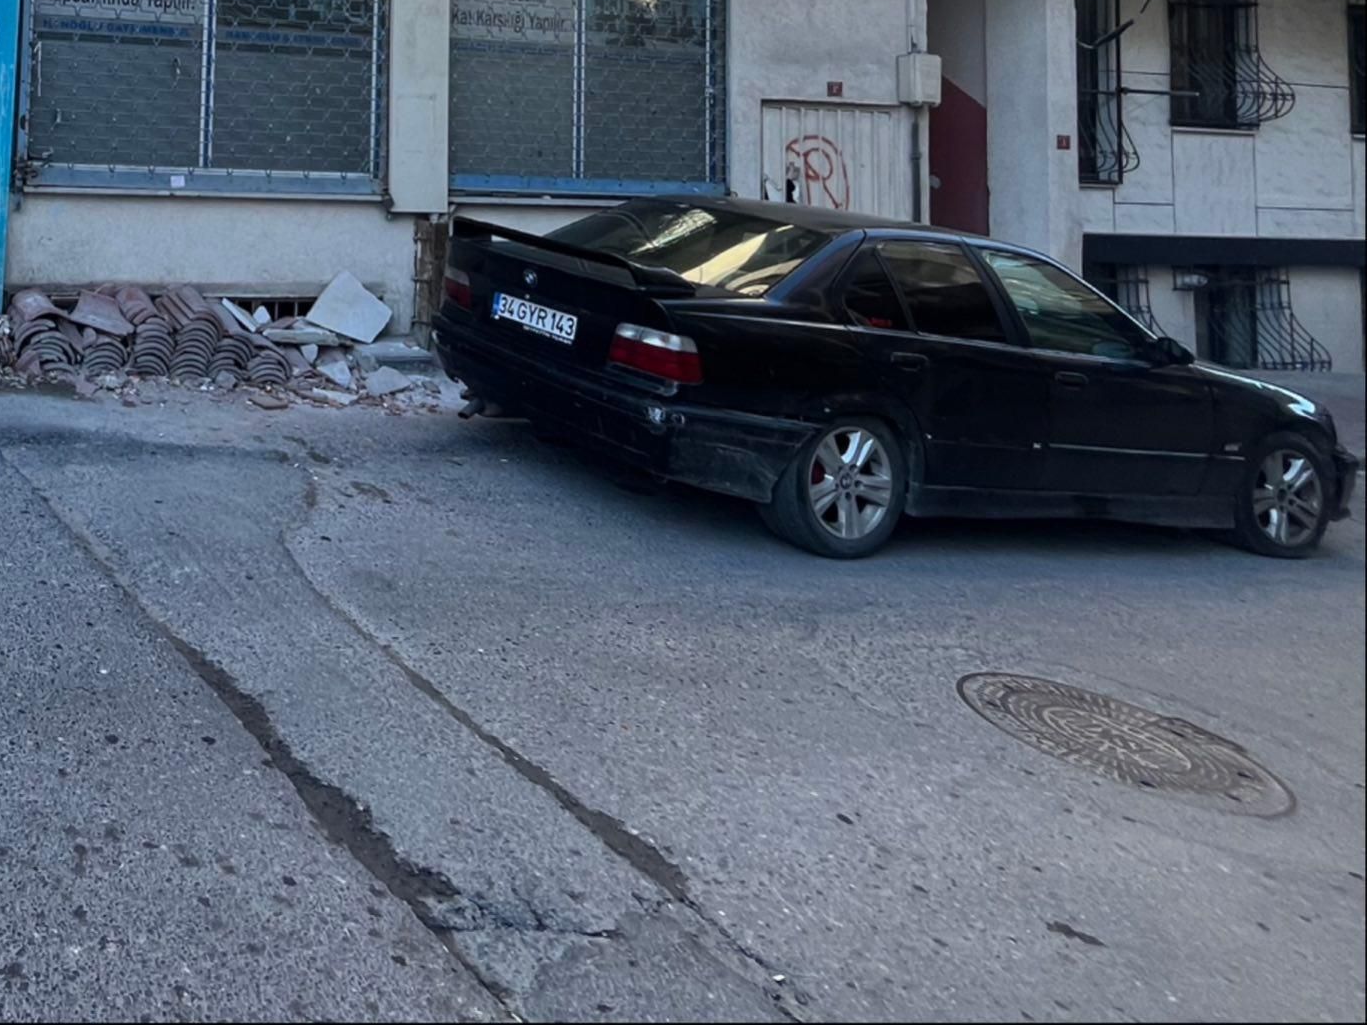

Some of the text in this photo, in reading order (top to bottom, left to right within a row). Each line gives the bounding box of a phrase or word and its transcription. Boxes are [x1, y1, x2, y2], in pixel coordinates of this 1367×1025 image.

[499, 296, 515, 316] 34
[517, 302, 548, 327] GYR
[551, 312, 576, 336] 143
